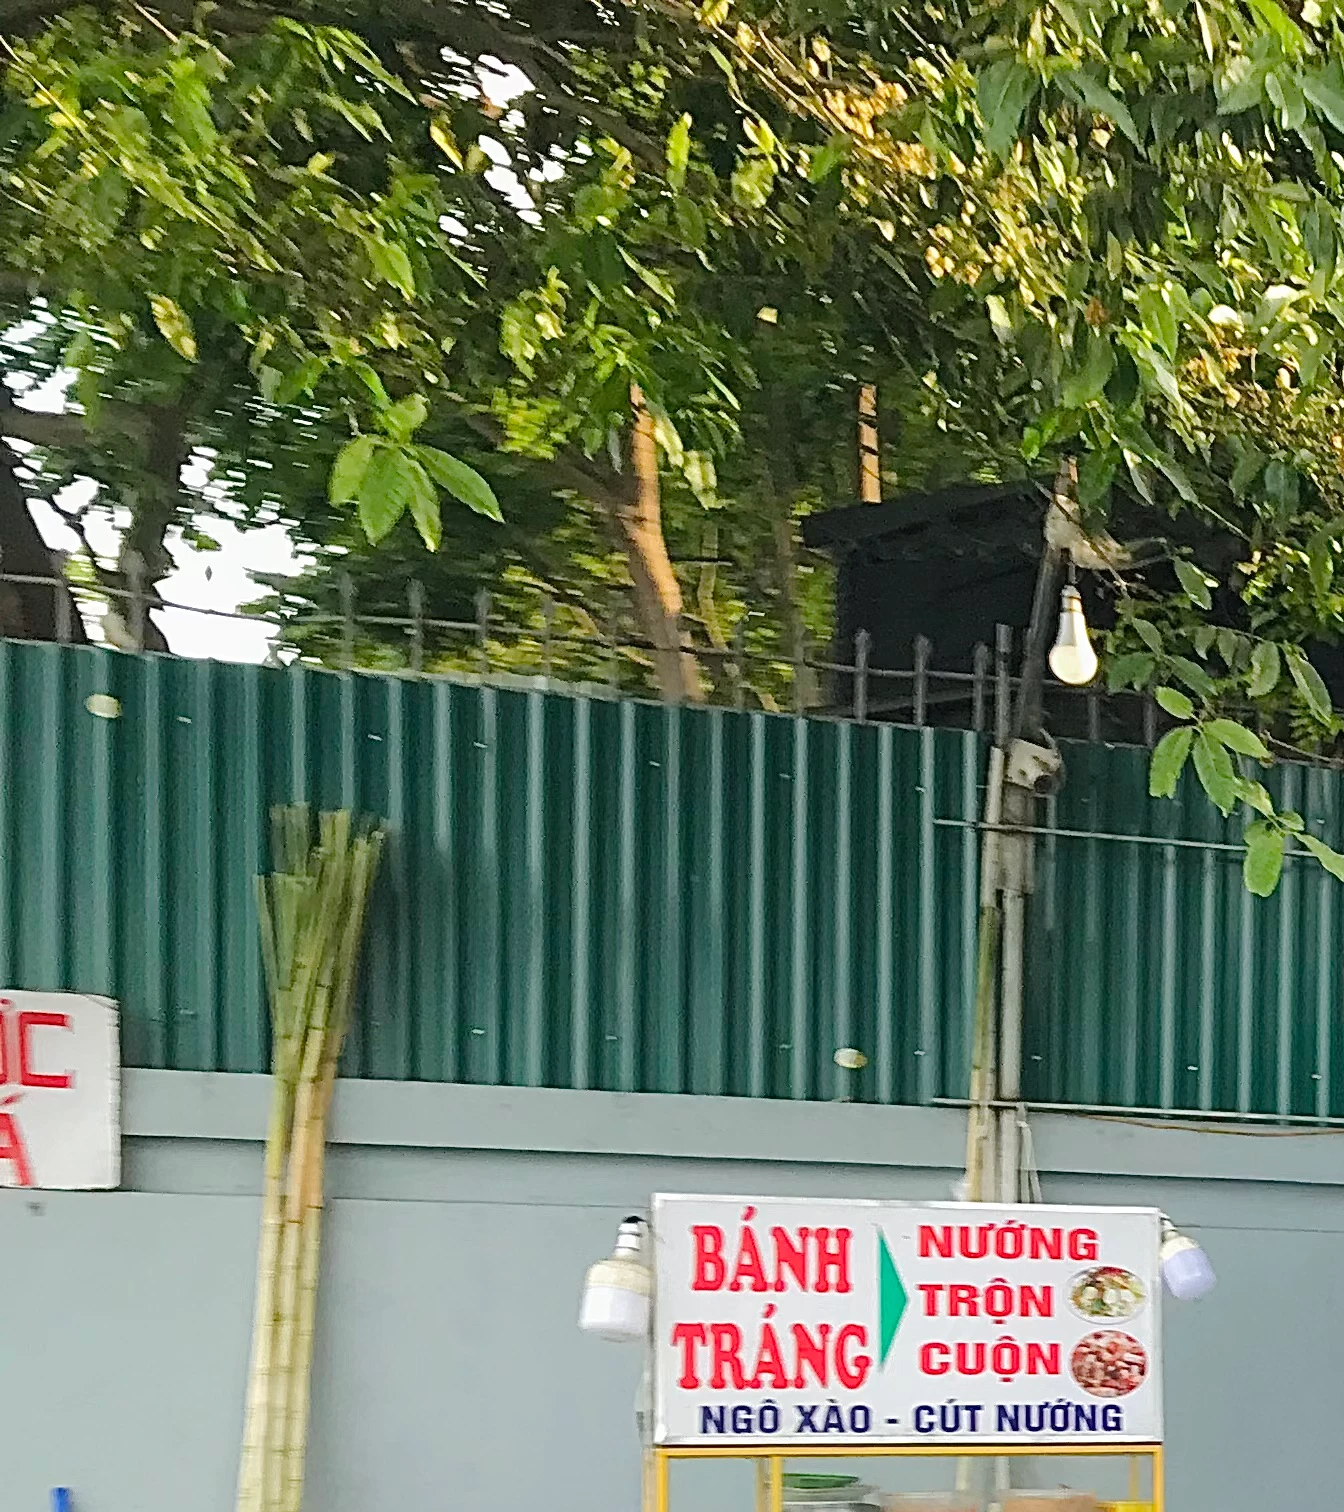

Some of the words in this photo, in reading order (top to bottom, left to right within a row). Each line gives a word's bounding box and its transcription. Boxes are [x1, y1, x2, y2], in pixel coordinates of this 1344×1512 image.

[690, 1205, 854, 1294] BÁNH
[917, 1219, 1098, 1262] NƯỚNG
[917, 1277, 1054, 1325] TRỘN
[671, 1303, 873, 1392] TRÁNG
[919, 1335, 1062, 1383] CUỘN
[699, 1398, 780, 1435] NGÔ
[796, 1397, 872, 1435] XÀO
[914, 1398, 982, 1435] CÚT
[995, 1398, 1124, 1434] NƯỚNG
